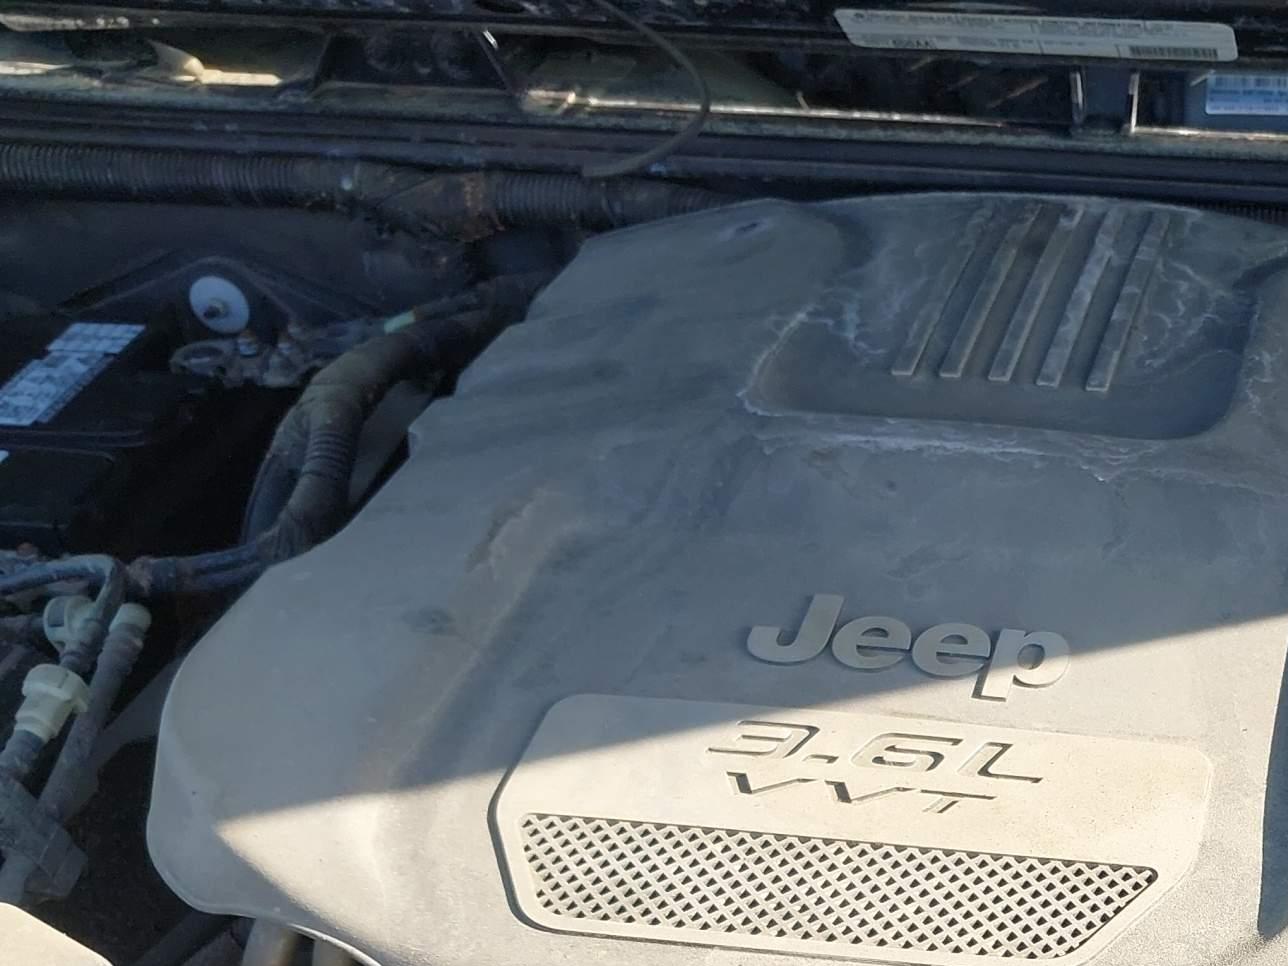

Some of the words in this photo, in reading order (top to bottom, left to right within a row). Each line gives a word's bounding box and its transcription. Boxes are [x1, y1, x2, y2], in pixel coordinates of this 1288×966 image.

[746, 593, 1071, 702] Jeep
[703, 718, 1045, 784] 3.6L
[724, 769, 998, 815] VVT
